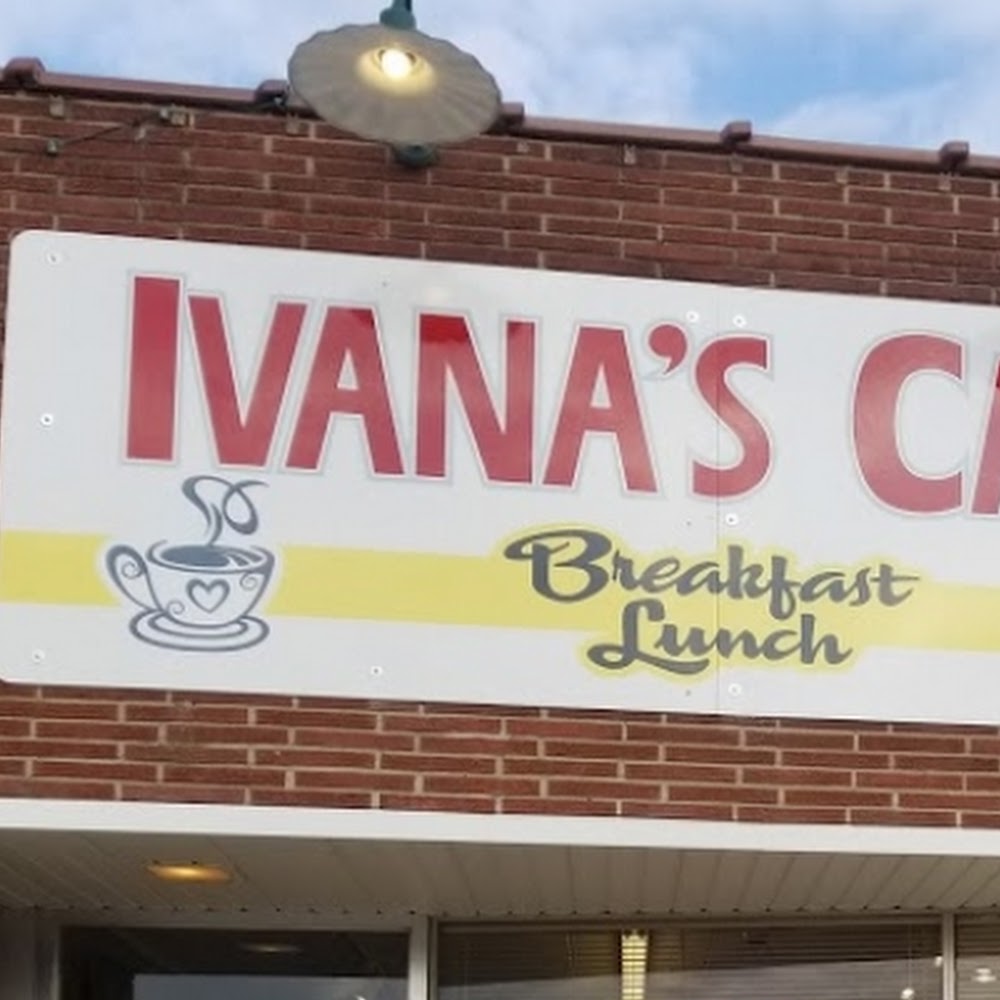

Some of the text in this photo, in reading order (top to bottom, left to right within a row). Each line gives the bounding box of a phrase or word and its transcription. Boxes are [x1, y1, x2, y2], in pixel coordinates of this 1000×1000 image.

[124, 275, 771, 497] IVANA'S
[504, 529, 920, 620] Breakfast
[587, 598, 852, 675] Lunch
